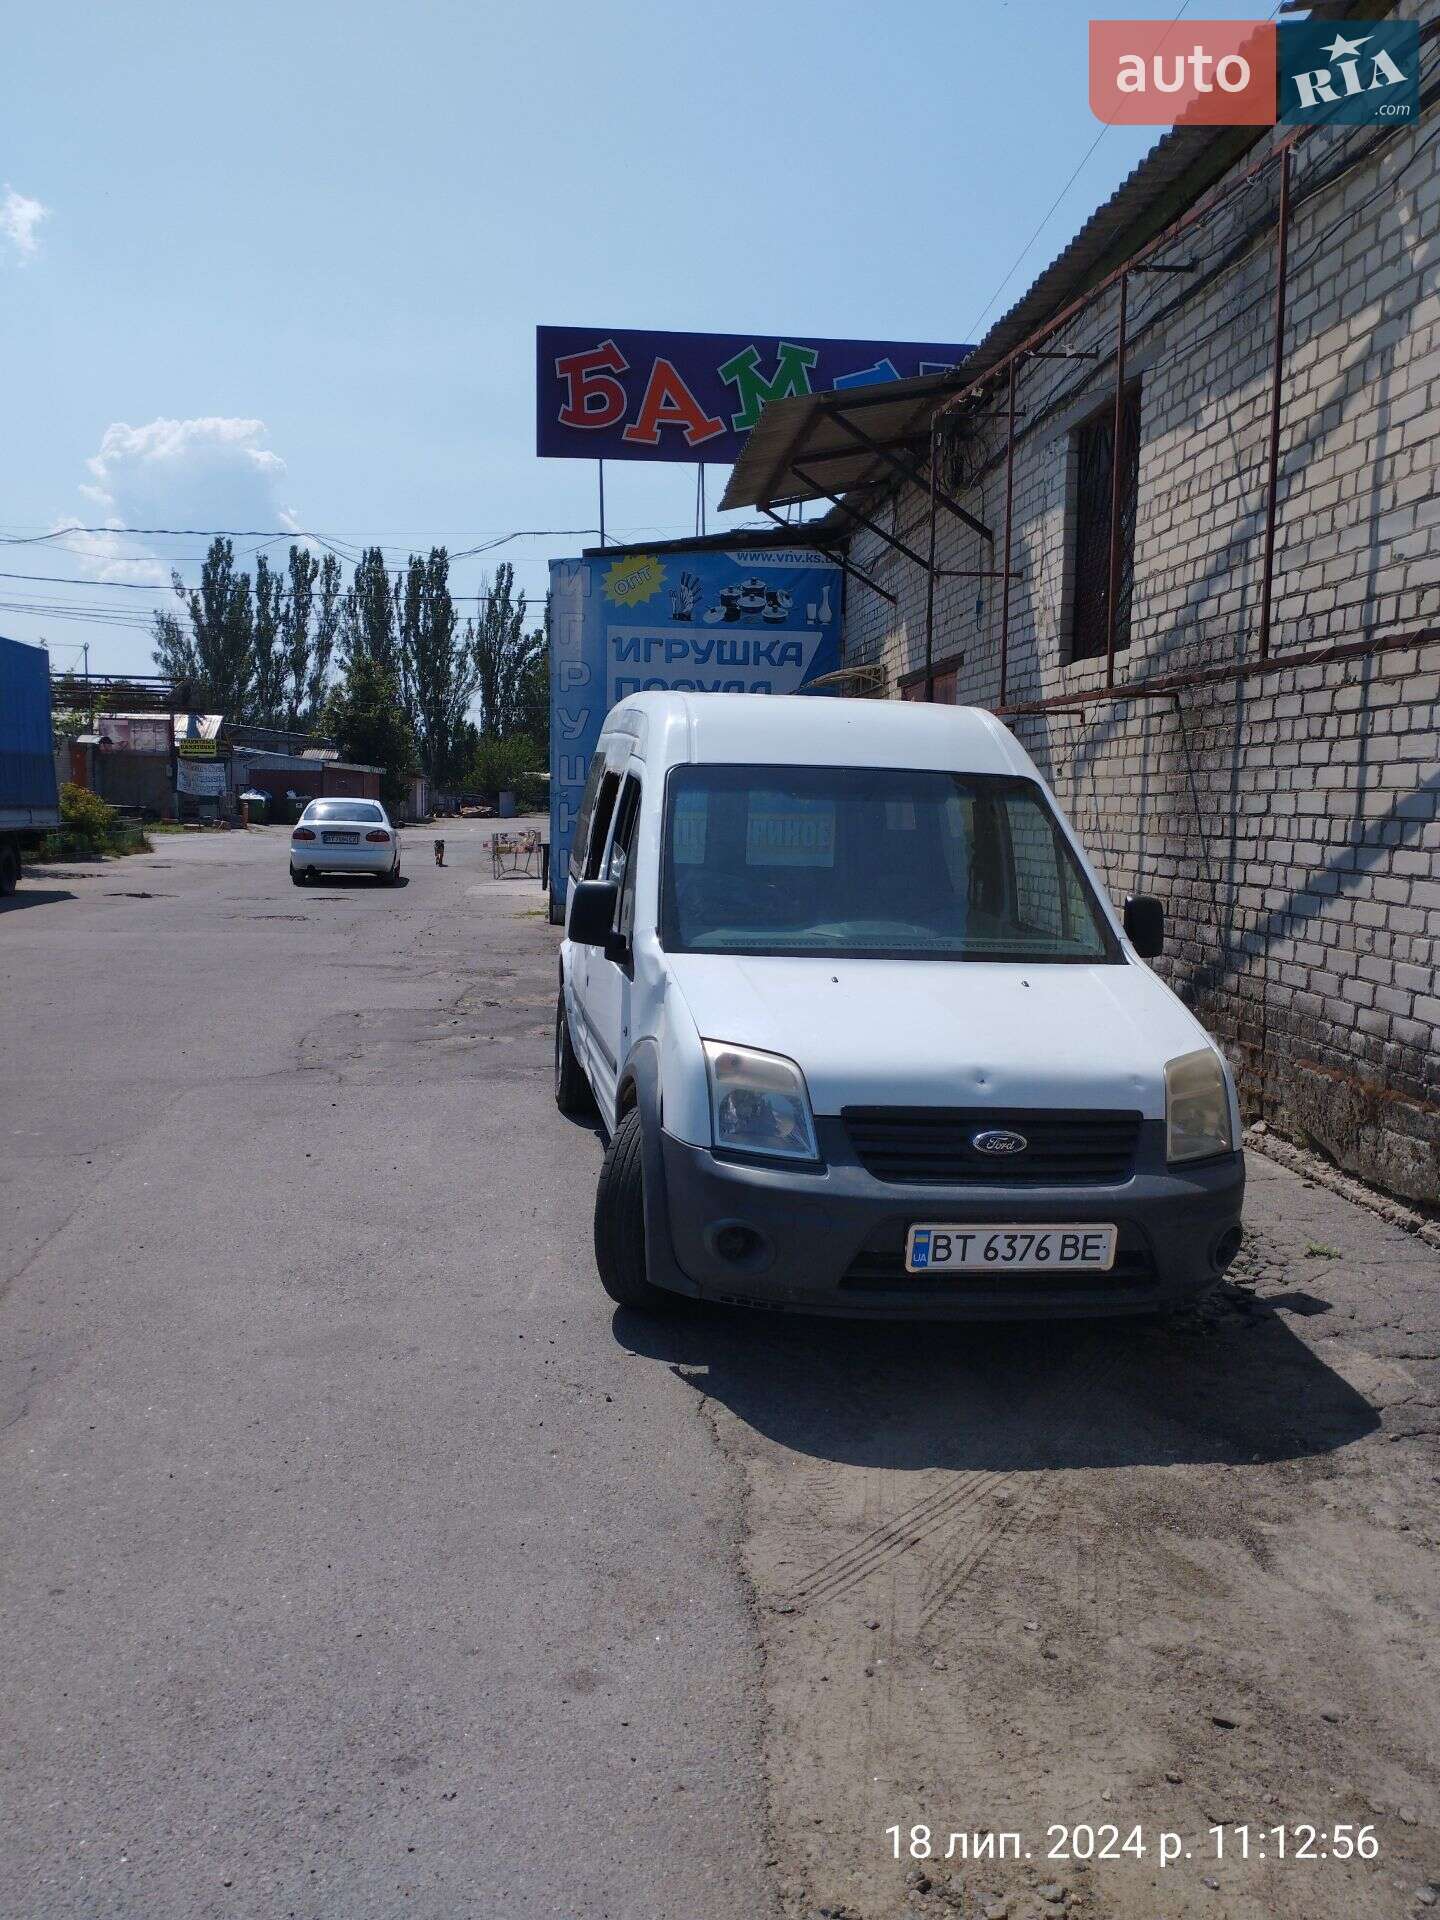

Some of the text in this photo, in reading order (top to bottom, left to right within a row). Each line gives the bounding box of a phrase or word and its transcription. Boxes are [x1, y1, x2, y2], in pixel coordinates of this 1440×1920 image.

[613, 564, 653, 596] ОПТ
[614, 636, 804, 667] ИГРУШКА
[987, 1136, 1016, 1151] Ford
[913, 1253, 928, 1263] UA
[932, 1234, 1103, 1263] BT 6376 BE
